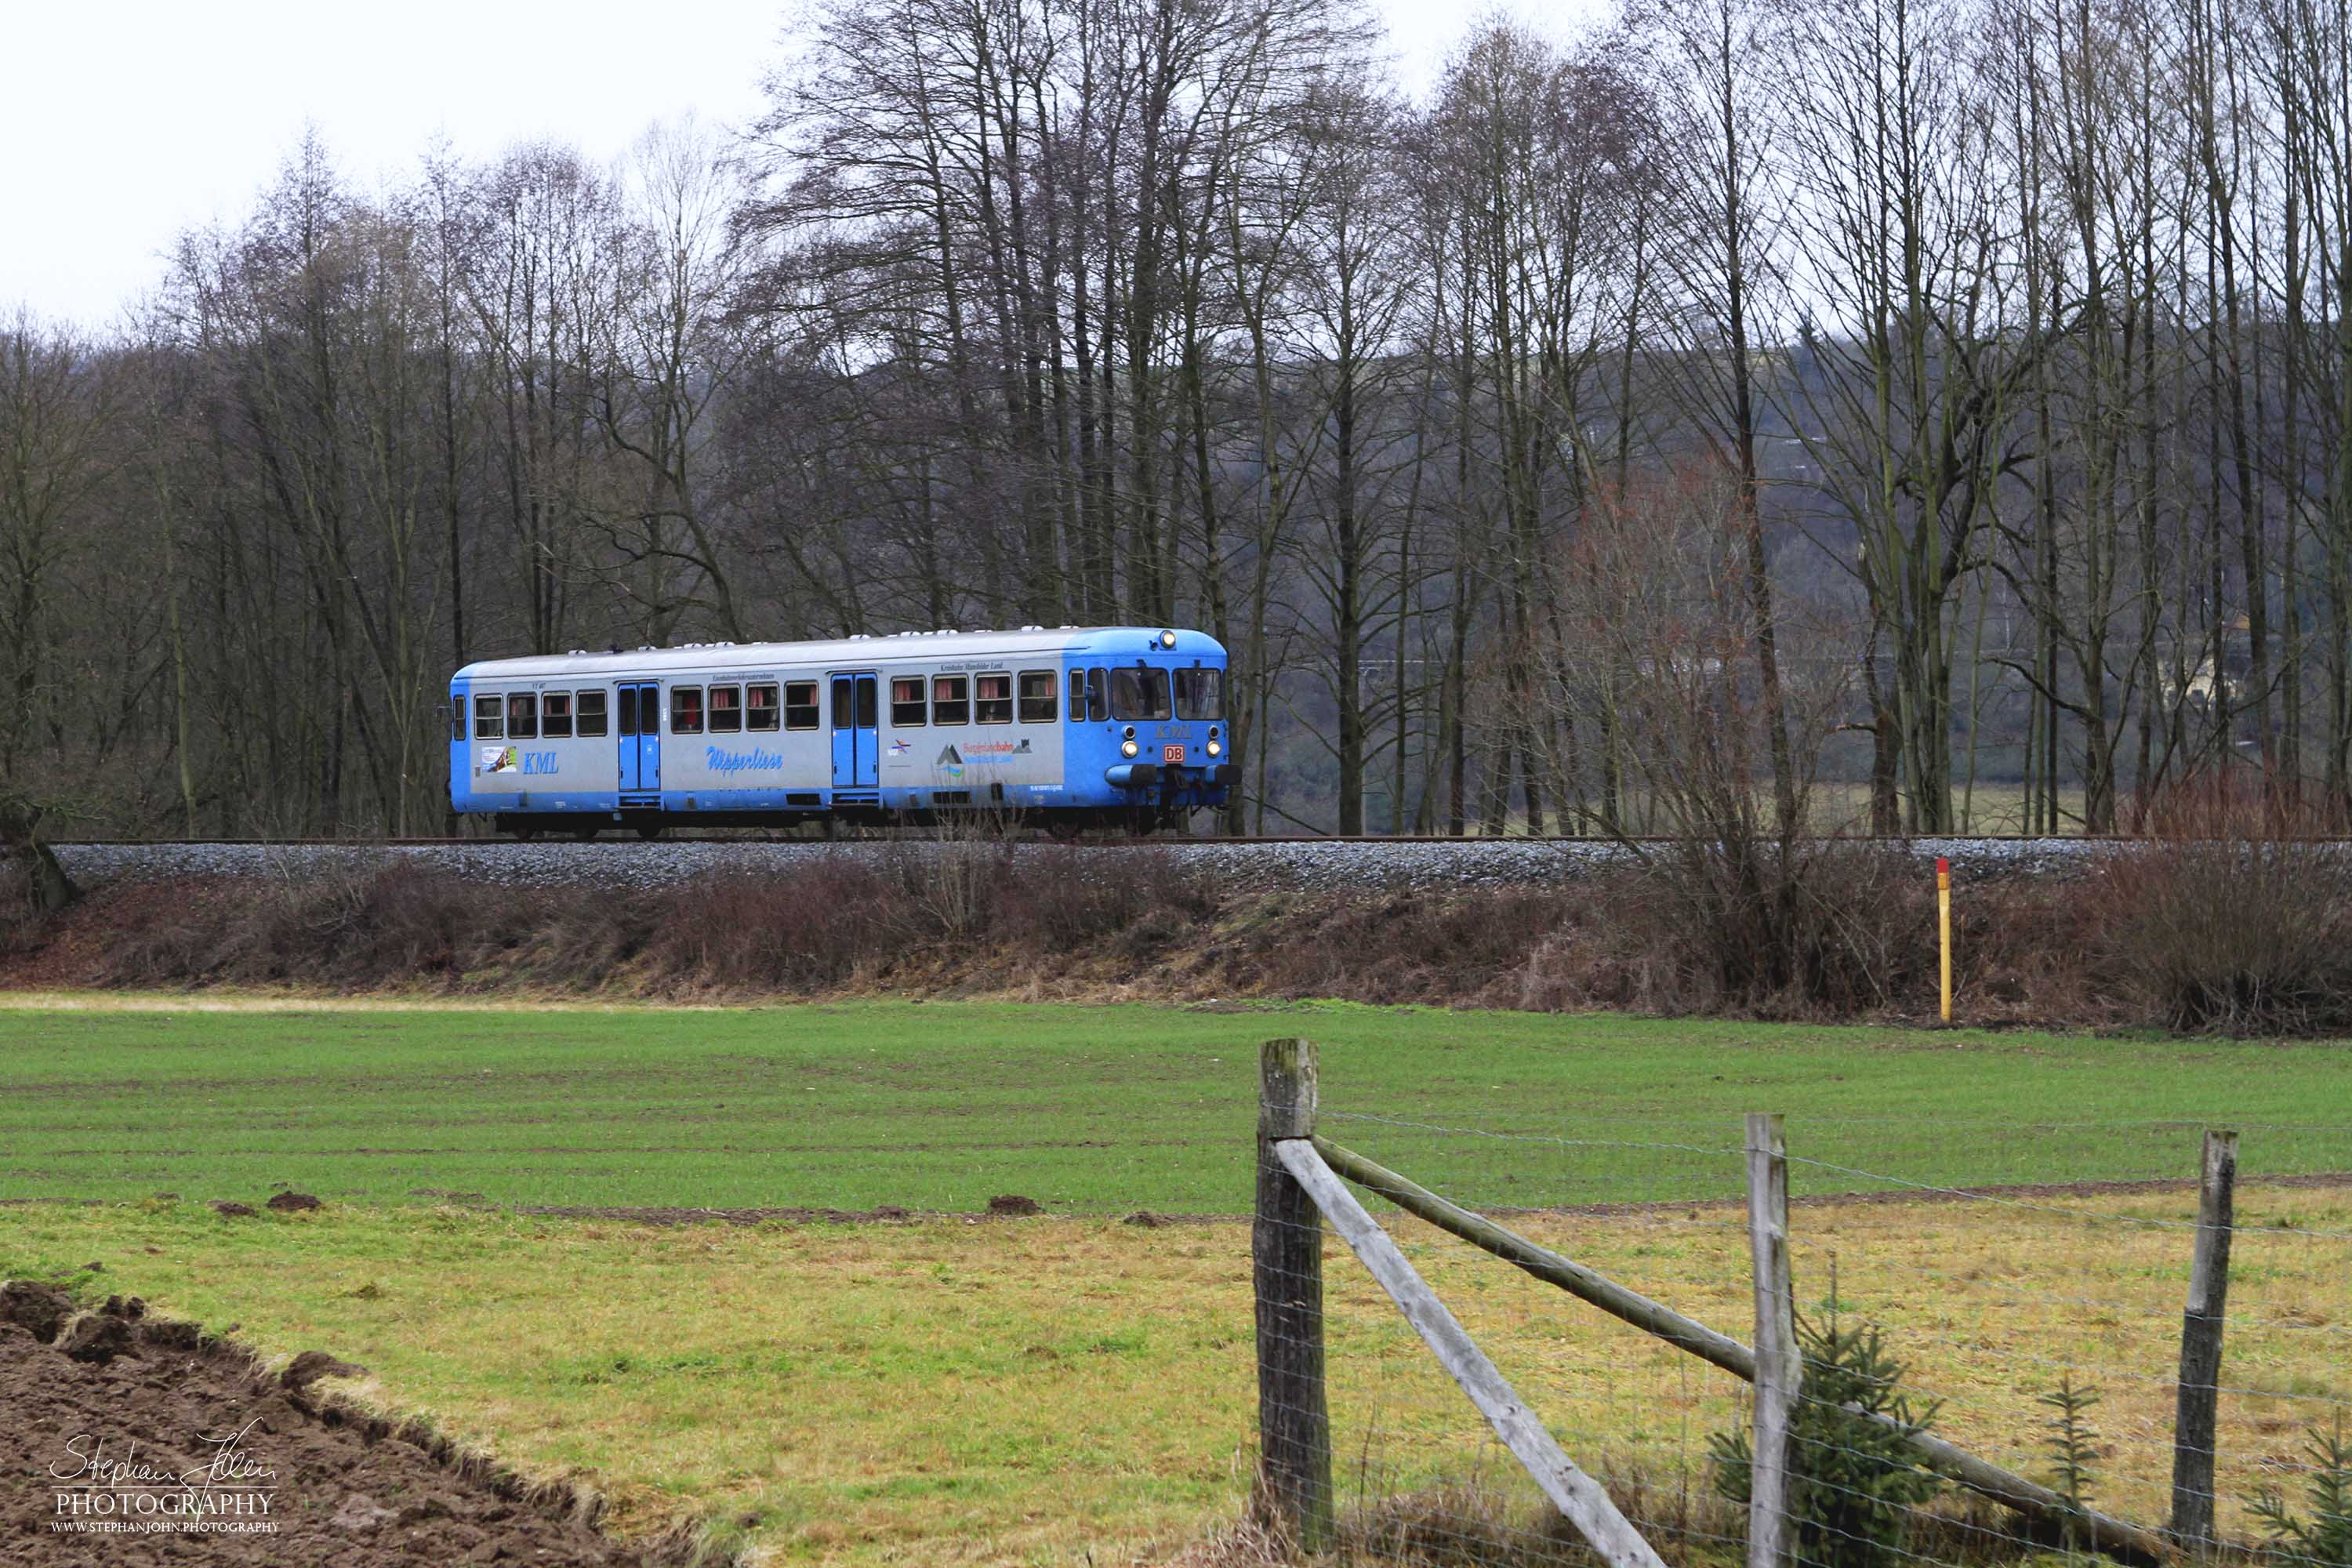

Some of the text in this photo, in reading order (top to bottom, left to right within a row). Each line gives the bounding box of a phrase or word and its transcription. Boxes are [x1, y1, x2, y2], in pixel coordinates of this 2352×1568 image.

[523, 752, 559, 775] KML
[706, 746, 783, 778] Wipperliese
[1165, 747, 1182, 760] DB
